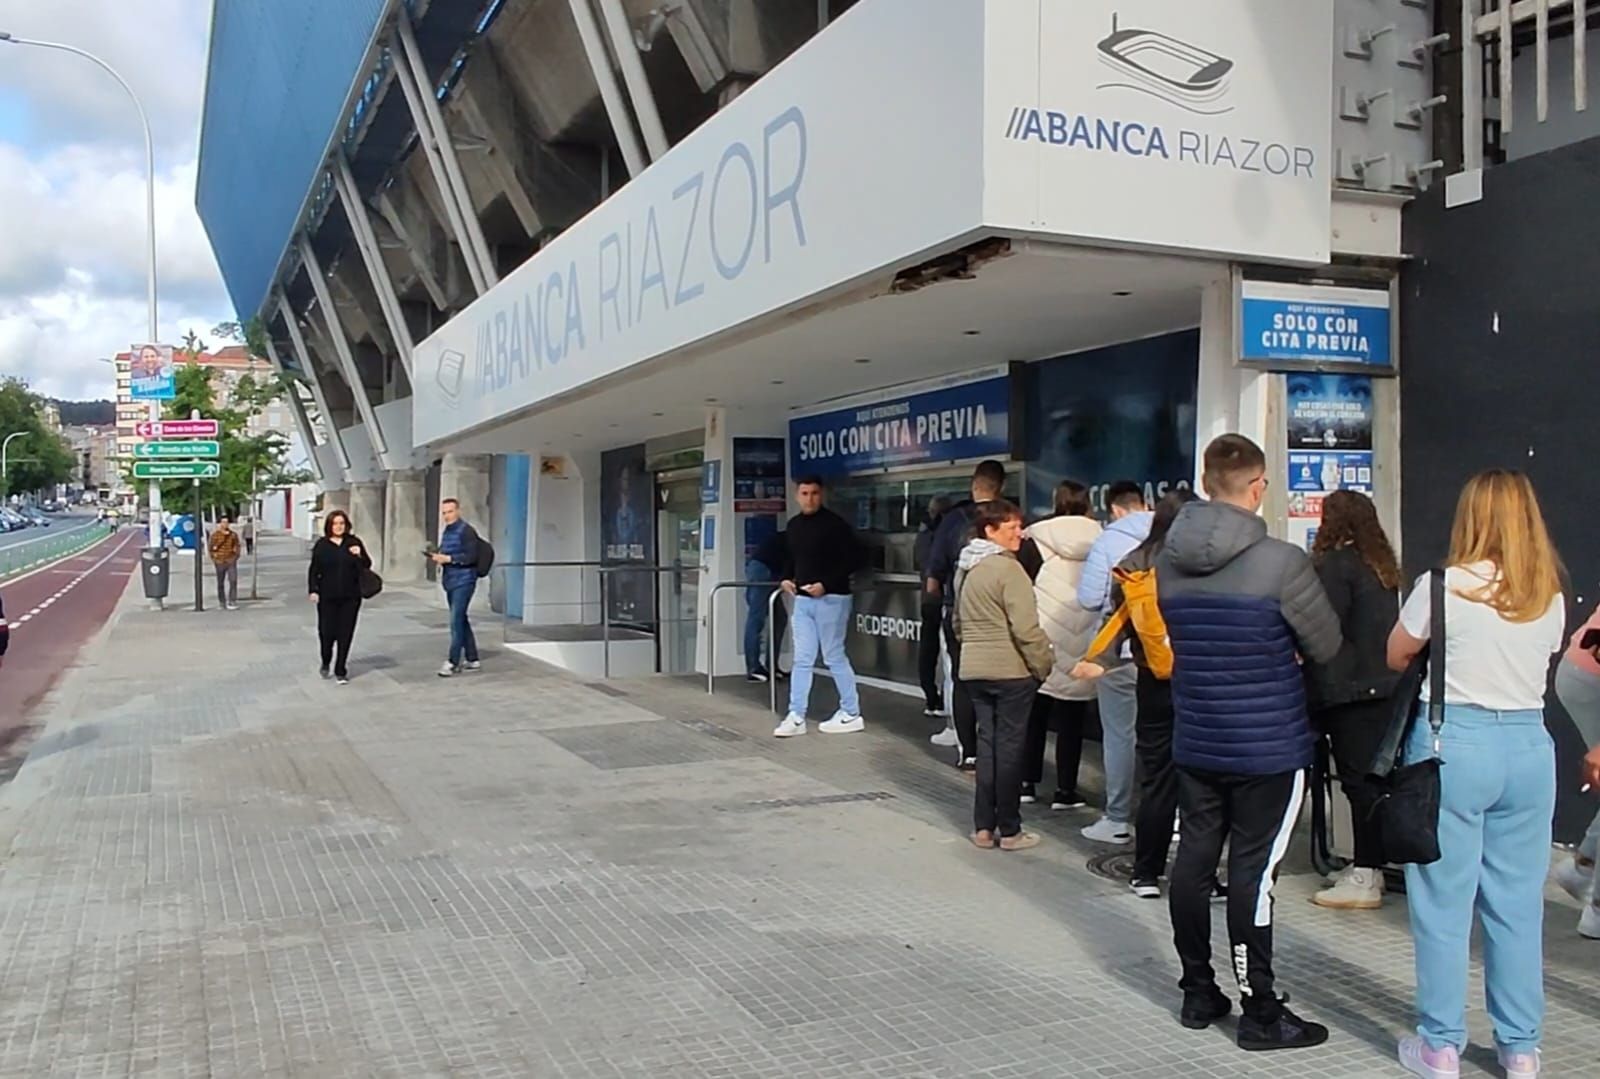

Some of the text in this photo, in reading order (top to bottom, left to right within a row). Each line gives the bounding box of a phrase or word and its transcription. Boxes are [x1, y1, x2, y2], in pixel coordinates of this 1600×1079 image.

[1178, 130, 1315, 178] RIAZOR
[600, 105, 807, 343] RIAZOR
[1262, 331, 1368, 352] CITA PREVIA
[1273, 313, 1358, 334] SOLO CON
[800, 430, 835, 461] SOLO
[839, 424, 870, 455] CON
[874, 418, 911, 450] CITA
[916, 404, 988, 444] PREVIA
